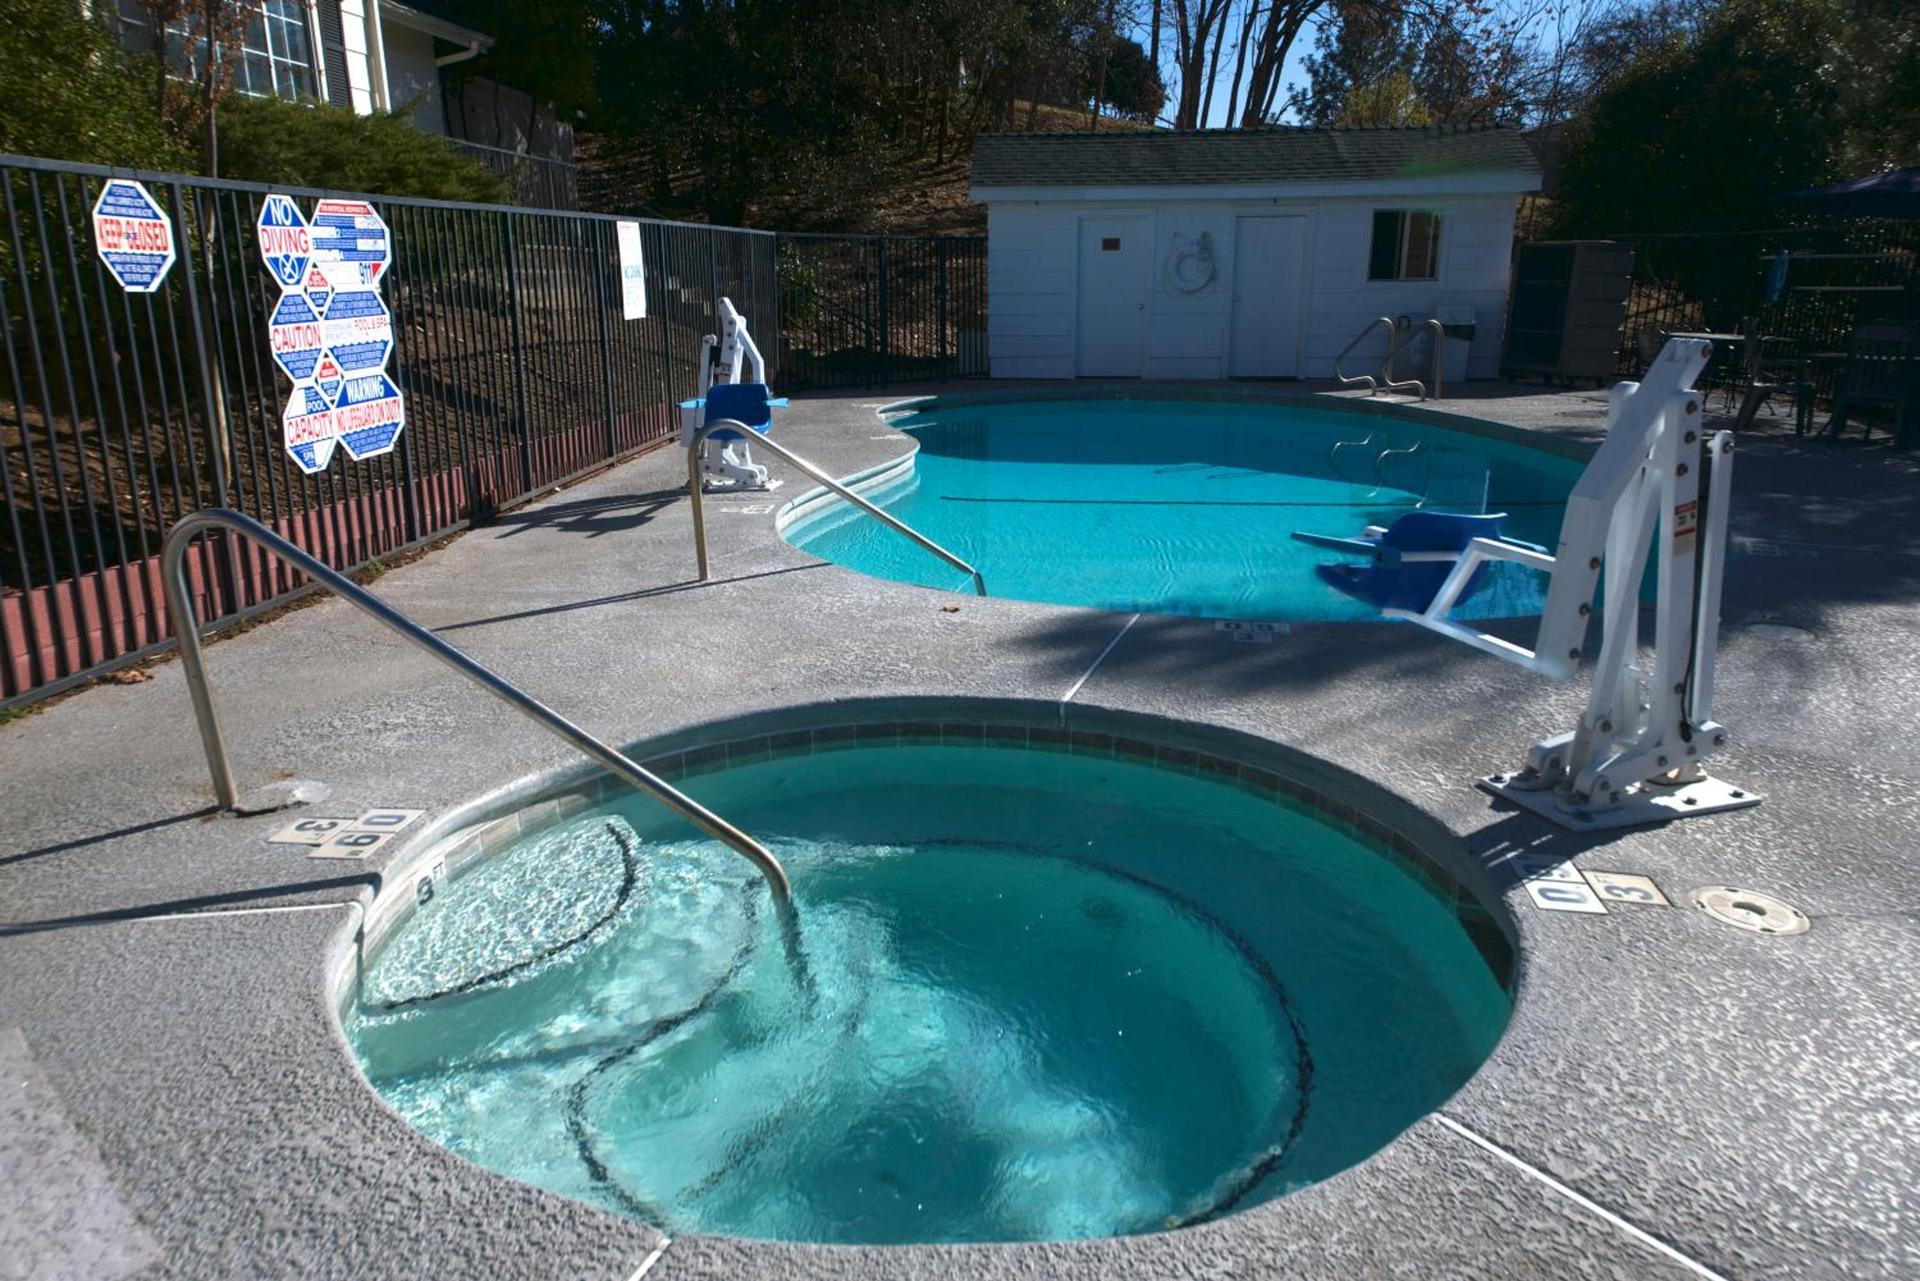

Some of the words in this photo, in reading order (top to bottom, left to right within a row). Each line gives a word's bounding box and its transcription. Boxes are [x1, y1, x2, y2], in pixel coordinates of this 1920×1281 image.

[270, 198, 292, 226] NO
[98, 218, 122, 250] KEEP
[126, 219, 169, 252] CLOSED
[260, 228, 309, 254] DIVING
[359, 261, 373, 285] 911
[272, 324, 321, 351] CAUTION
[345, 375, 385, 404] WARNING
[306, 399, 326, 412] POOL
[287, 412, 334, 444] CAPACITY
